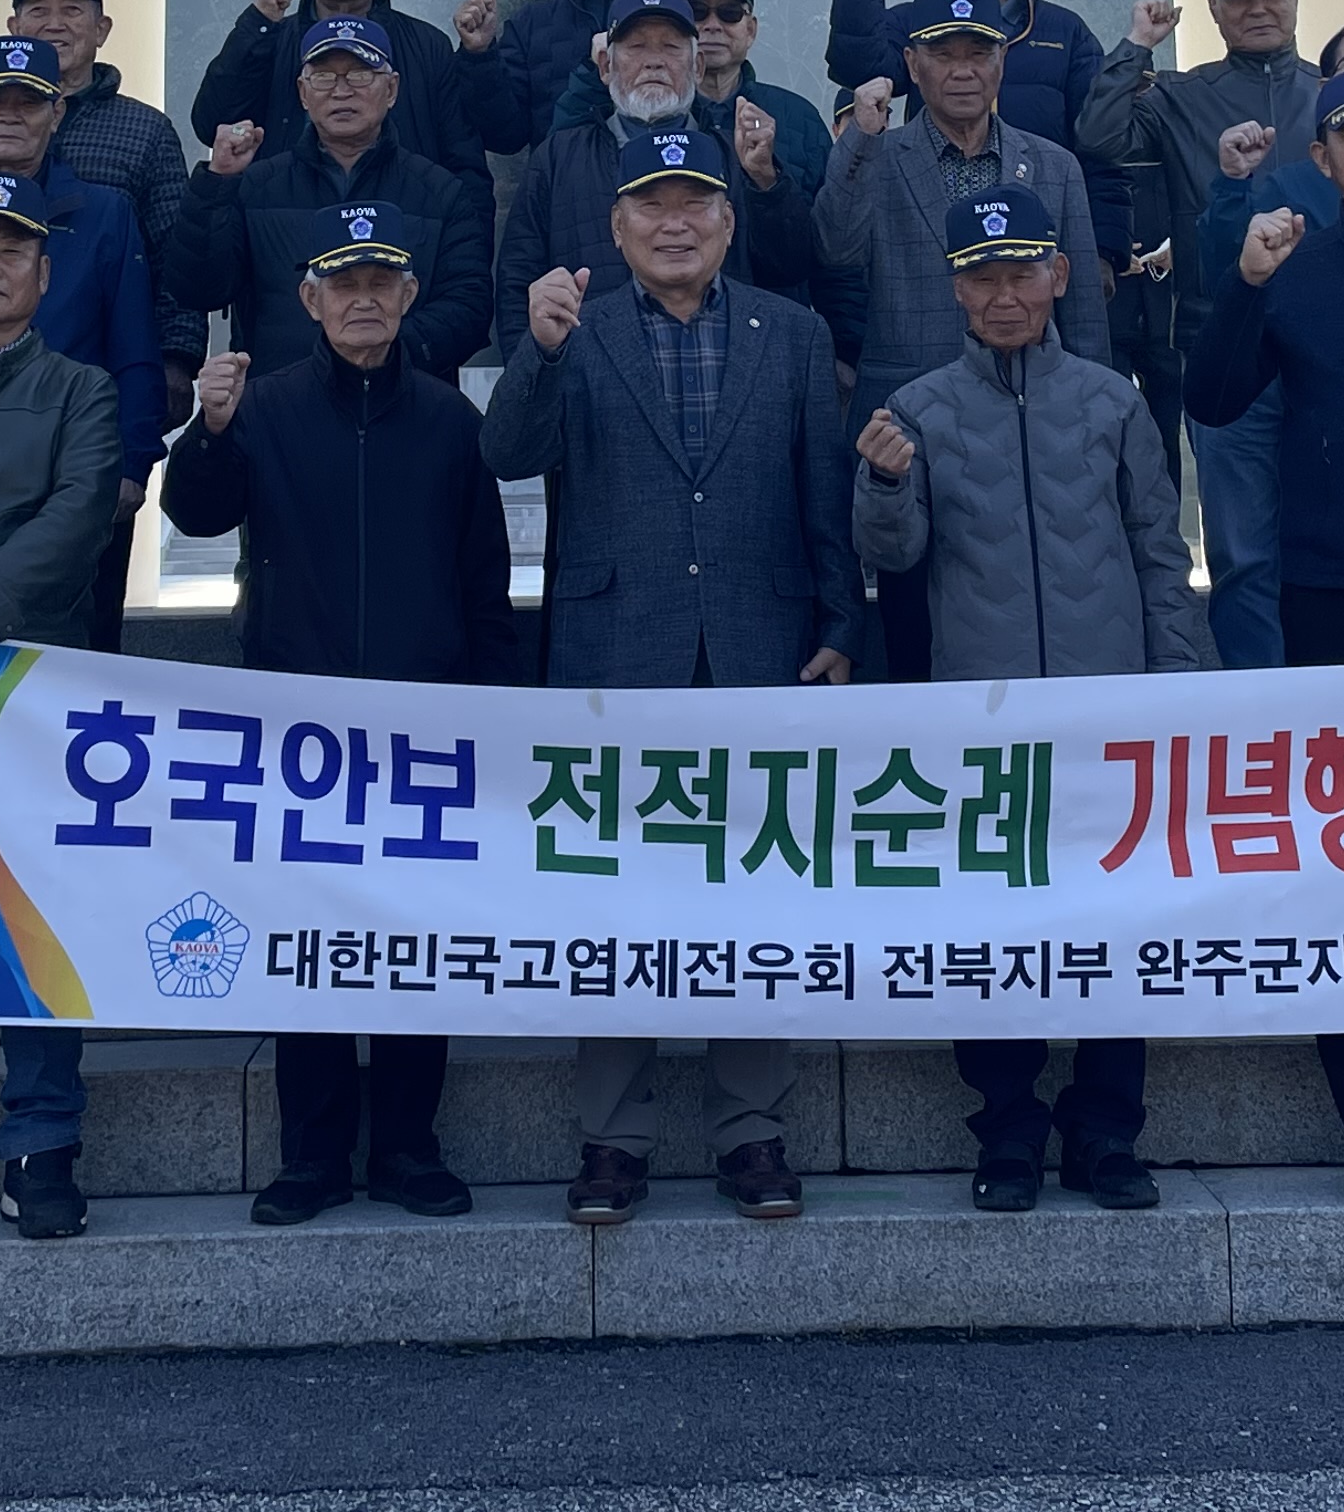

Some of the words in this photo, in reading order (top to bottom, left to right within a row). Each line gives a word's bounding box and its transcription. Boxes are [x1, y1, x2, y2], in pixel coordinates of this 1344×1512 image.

[328, 21, 364, 30] KAOVA
[0, 41, 34, 52] KAOVA
[653, 134, 689, 145] KAOVA
[340, 207, 377, 219] KAOVA
[974, 202, 1010, 213] KAOVA
[54, 700, 479, 866] 호국안보
[527, 741, 1053, 889] 전적지순례
[174, 942, 220, 954] KAOVA
[266, 929, 855, 1001] 대한민국고엽제전우회
[881, 940, 1113, 1000] 전북지부
